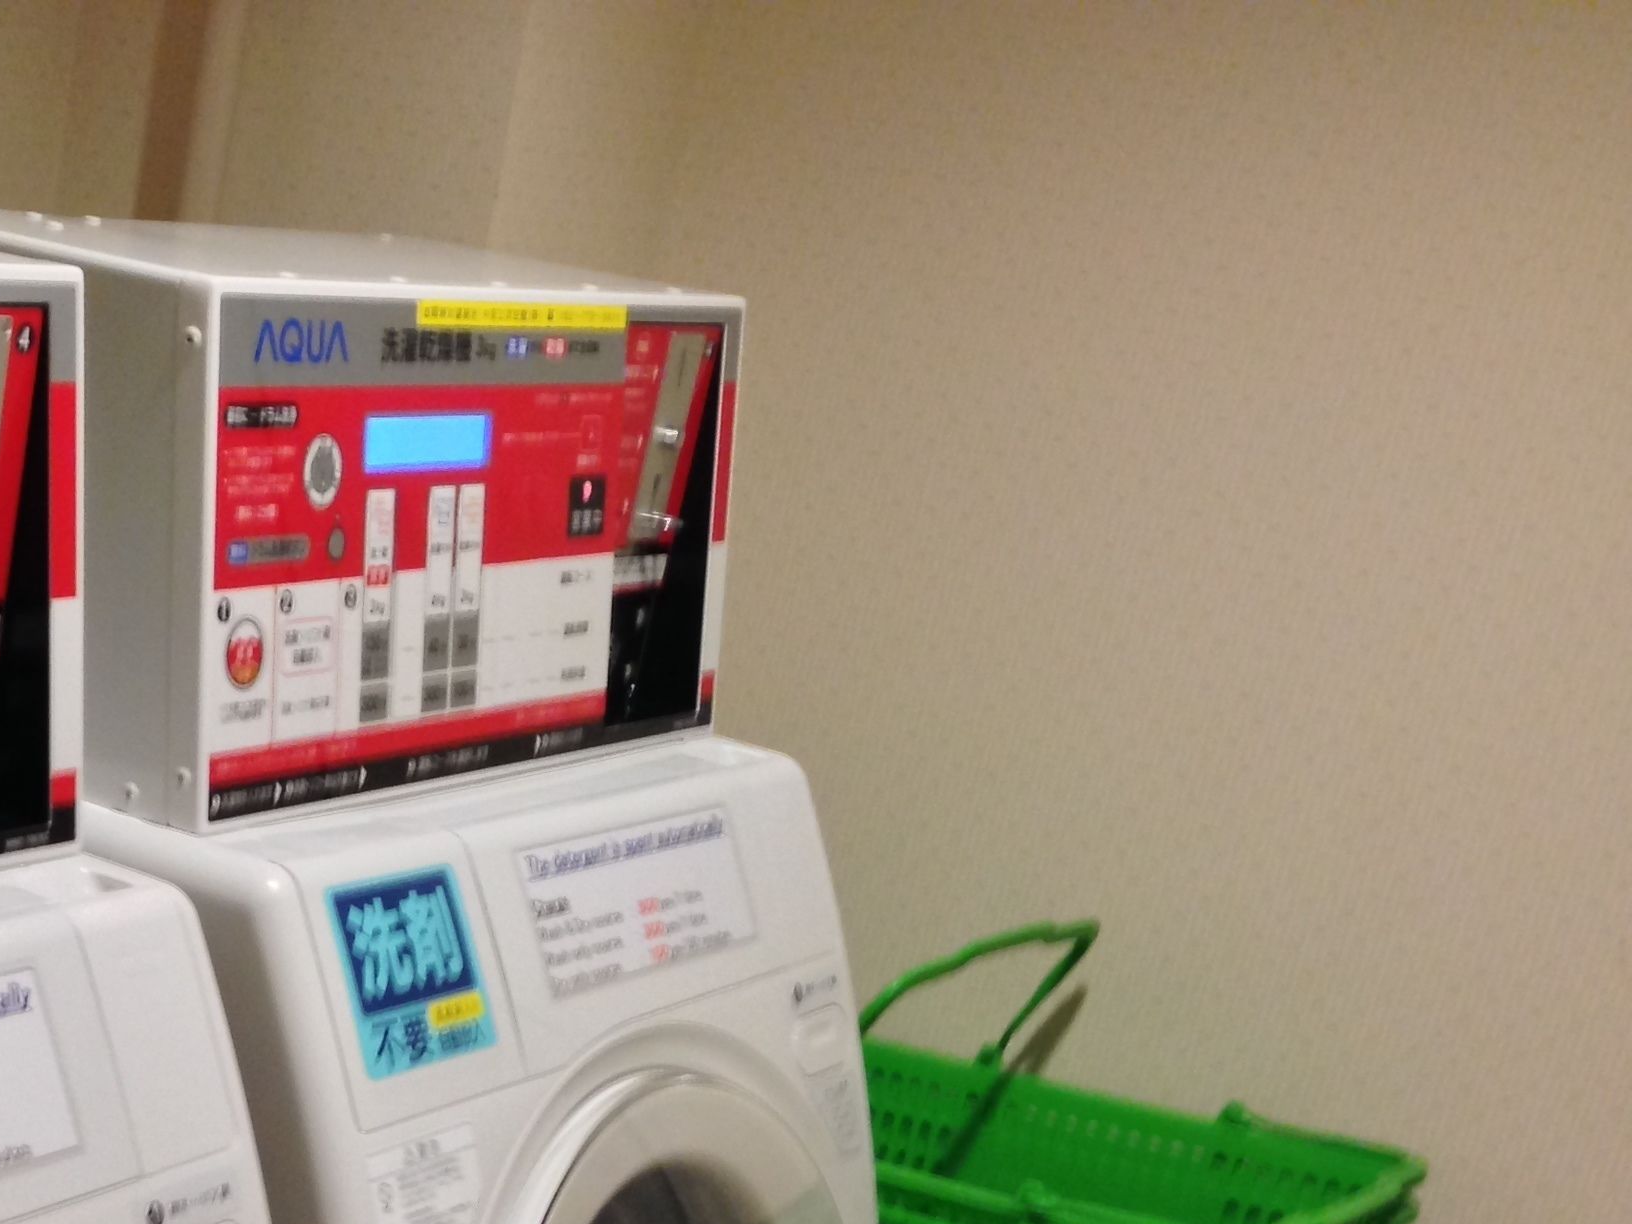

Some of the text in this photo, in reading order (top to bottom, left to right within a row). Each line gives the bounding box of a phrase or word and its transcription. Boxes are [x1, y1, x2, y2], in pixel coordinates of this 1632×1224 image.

[253, 318, 349, 365] AQUA
[347, 884, 465, 999] 洗剤
[371, 1013, 434, 1073] 不要
